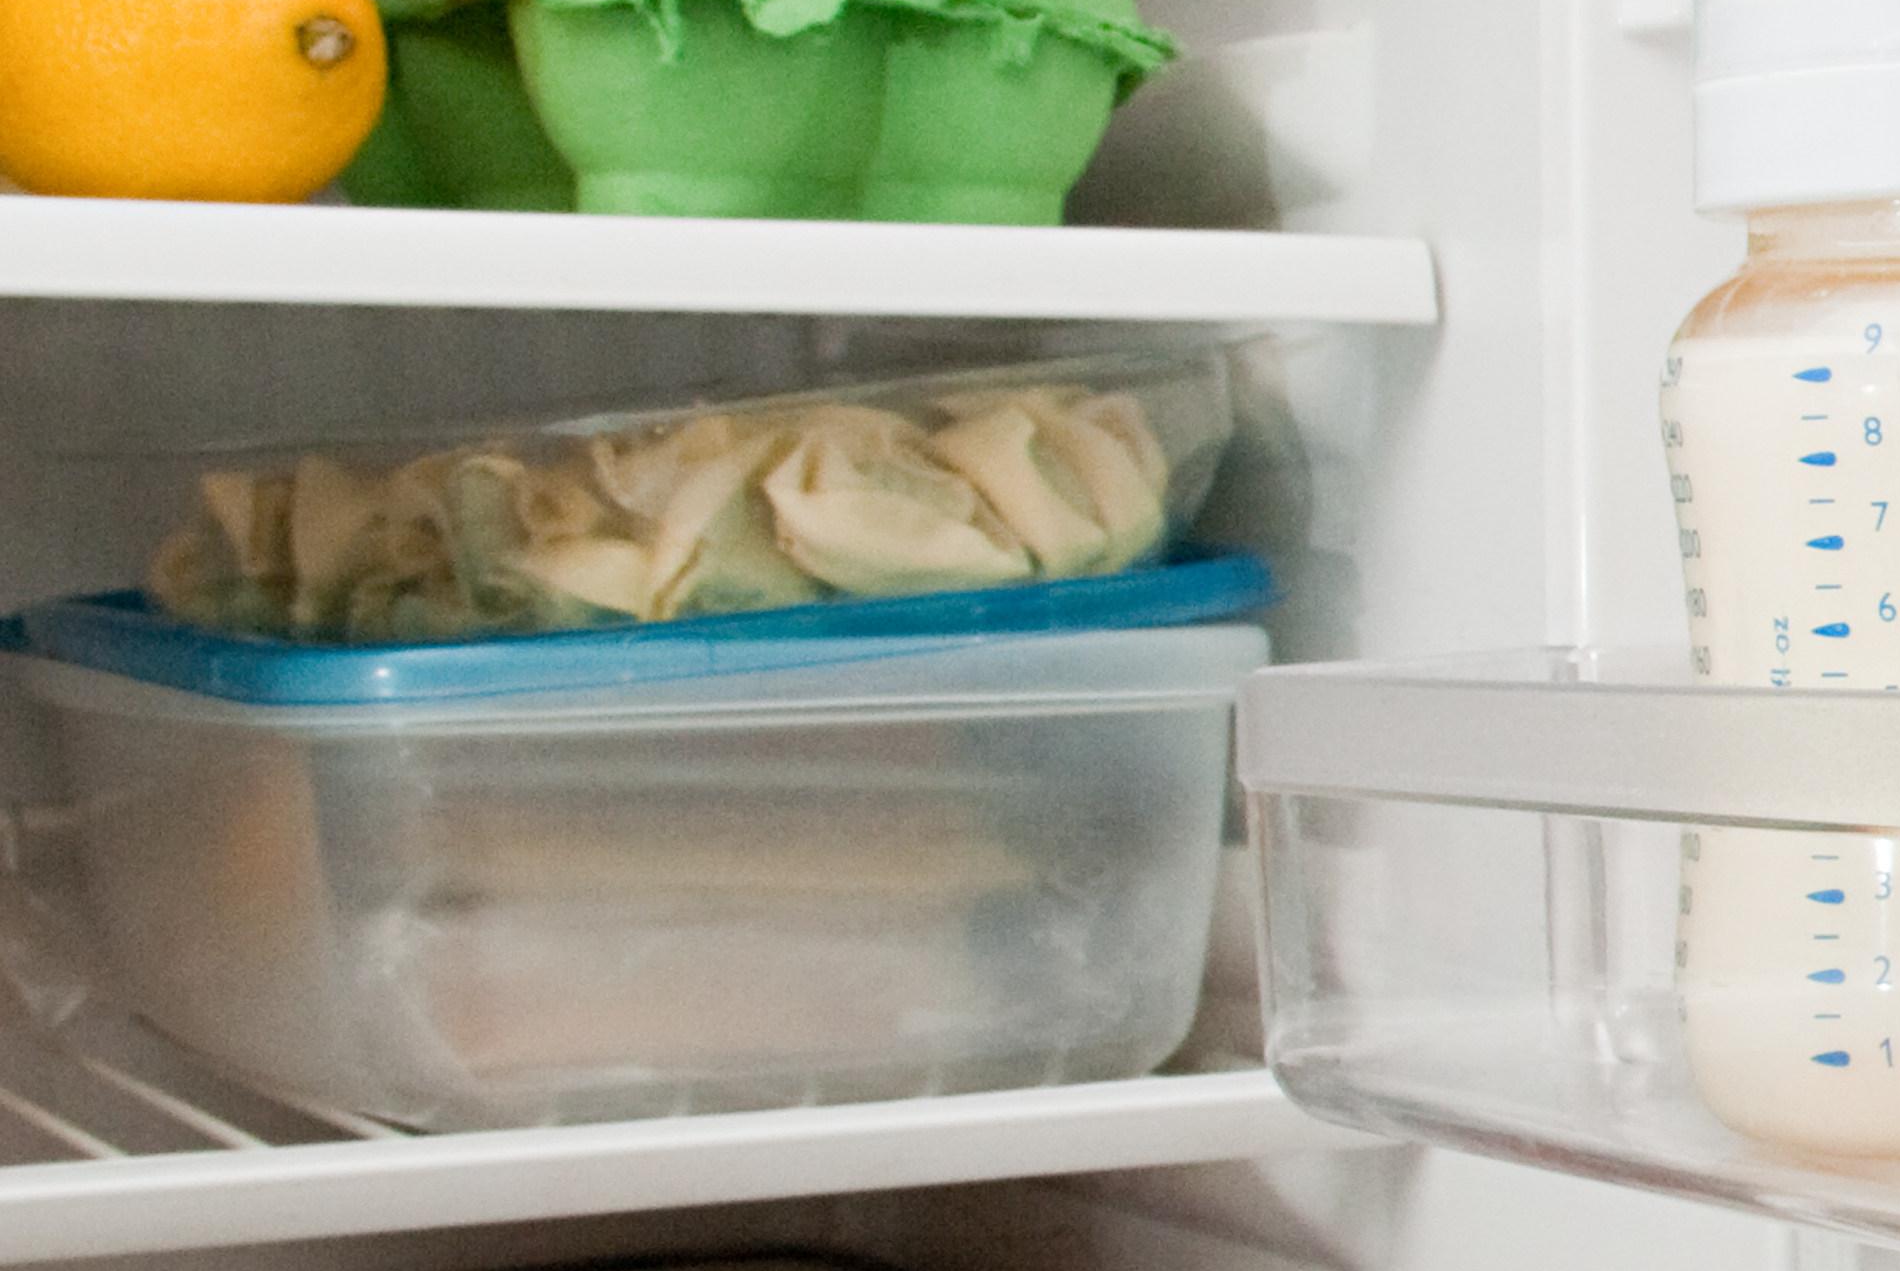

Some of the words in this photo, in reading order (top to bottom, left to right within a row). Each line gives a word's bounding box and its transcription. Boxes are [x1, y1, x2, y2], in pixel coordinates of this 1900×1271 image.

[1864, 323, 1882, 352] 9
[1863, 416, 1882, 446] 8
[1871, 501, 1888, 531] 7
[1878, 593, 1897, 622] 6
[1874, 873, 1892, 901] 3
[1874, 955, 1891, 985] 2
[1880, 1037, 1893, 1067] 1
